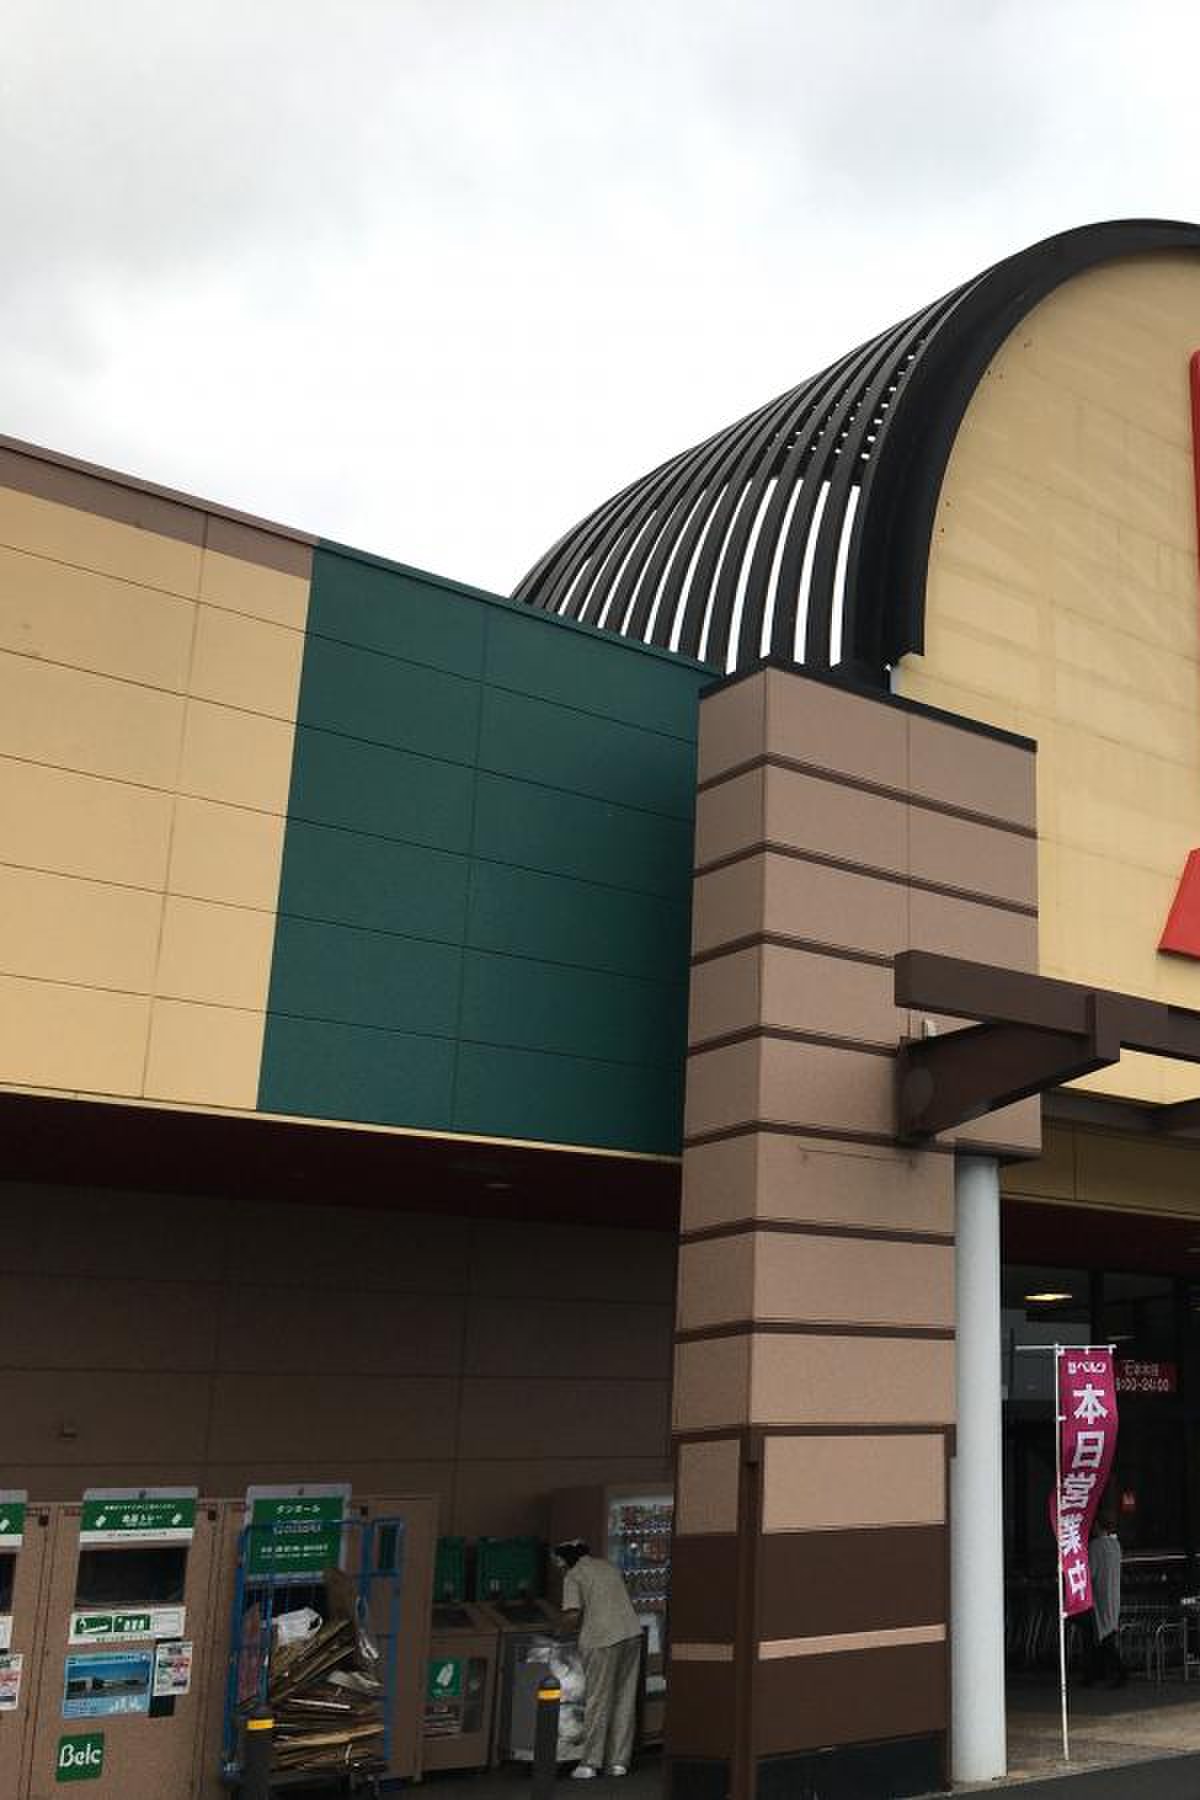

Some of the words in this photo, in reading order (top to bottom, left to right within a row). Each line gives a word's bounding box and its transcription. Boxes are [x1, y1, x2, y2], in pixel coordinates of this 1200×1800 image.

[1058, 1384, 1108, 1601] 本日営業中
[58, 1743, 102, 1768] Belc
